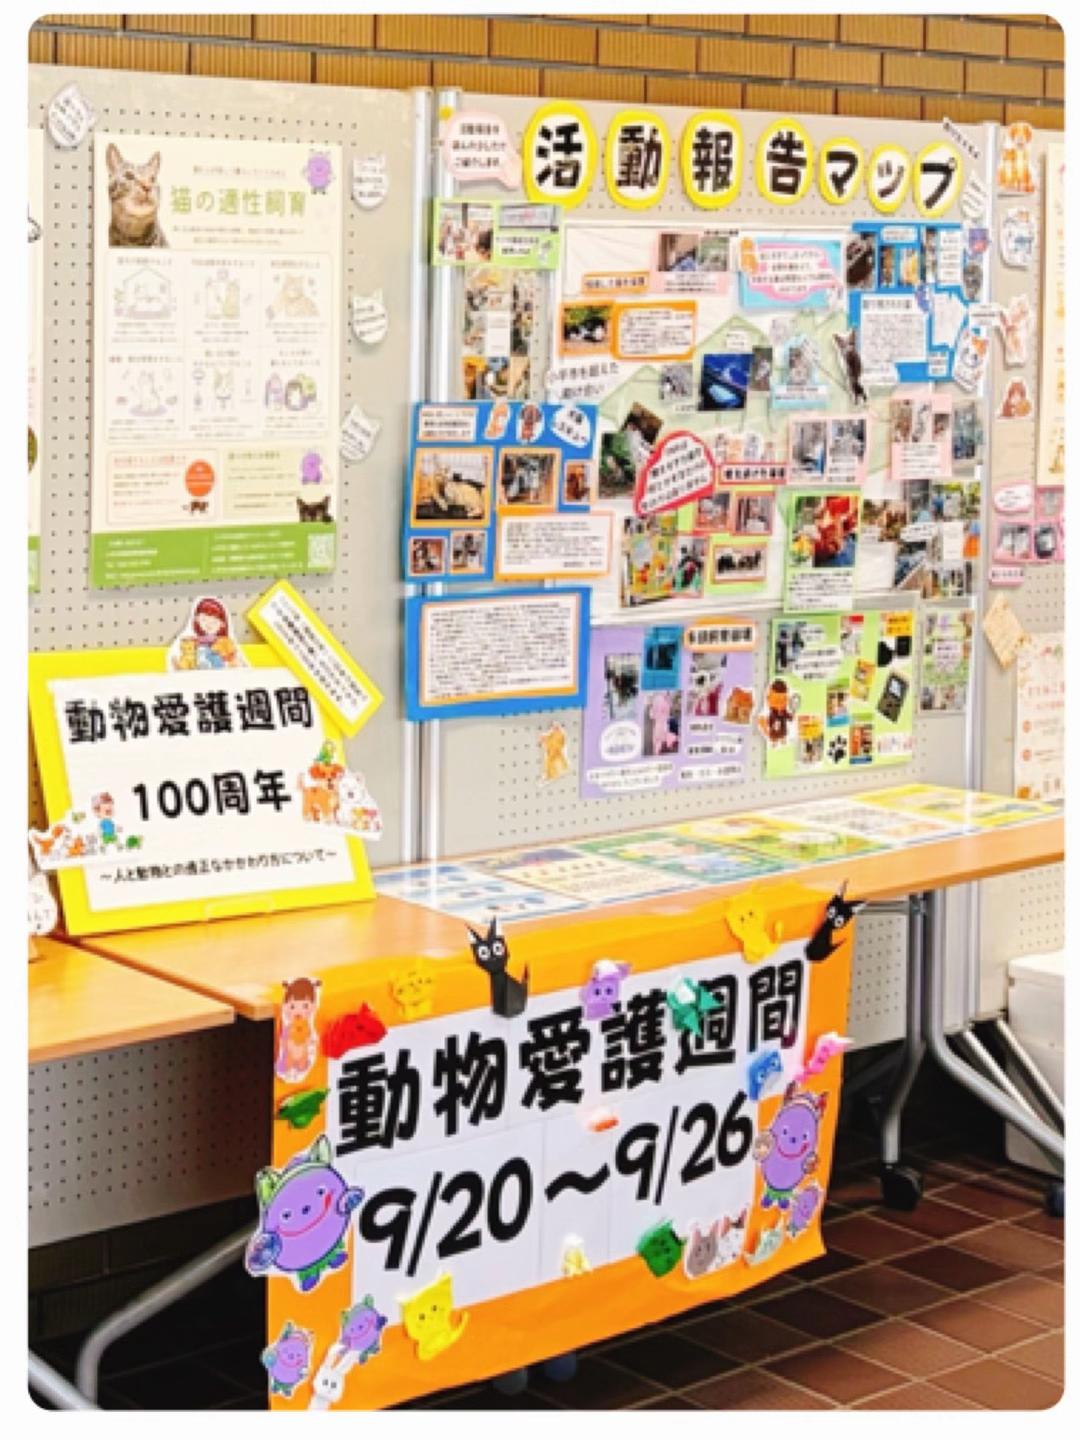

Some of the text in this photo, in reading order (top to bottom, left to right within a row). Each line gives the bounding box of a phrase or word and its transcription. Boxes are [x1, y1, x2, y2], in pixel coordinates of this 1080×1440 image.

[535, 121, 959, 211] 活動報告マップ
[64, 686, 313, 744] 動物愛護週間
[131, 769, 291, 821] 100周年
[336, 958, 806, 1158] 動物愛護週間
